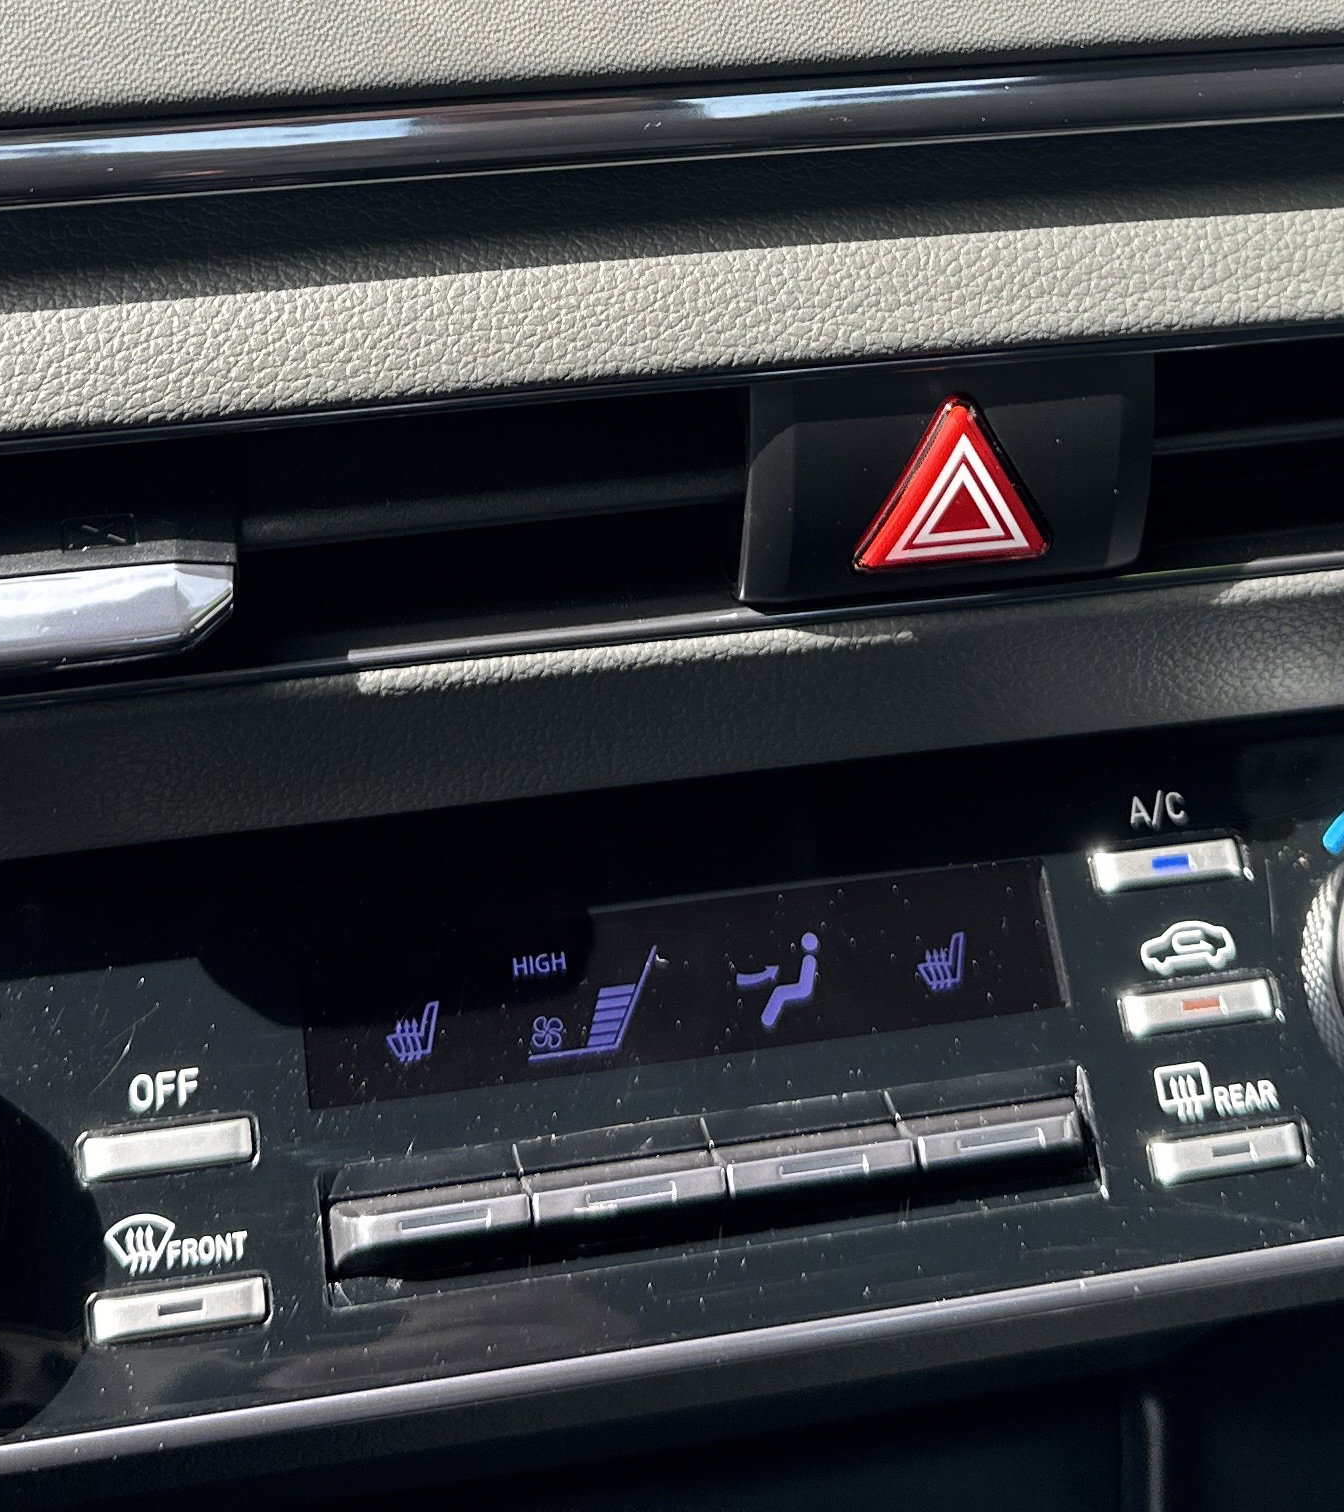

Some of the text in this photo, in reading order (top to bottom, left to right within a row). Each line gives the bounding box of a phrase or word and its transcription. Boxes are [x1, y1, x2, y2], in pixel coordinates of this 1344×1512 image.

[1131, 790, 1186, 825] A/C
[513, 952, 566, 976] HIGH
[129, 1067, 198, 1112] OFF
[1213, 1079, 1279, 1116] REAR
[166, 1229, 247, 1268] FRONT
